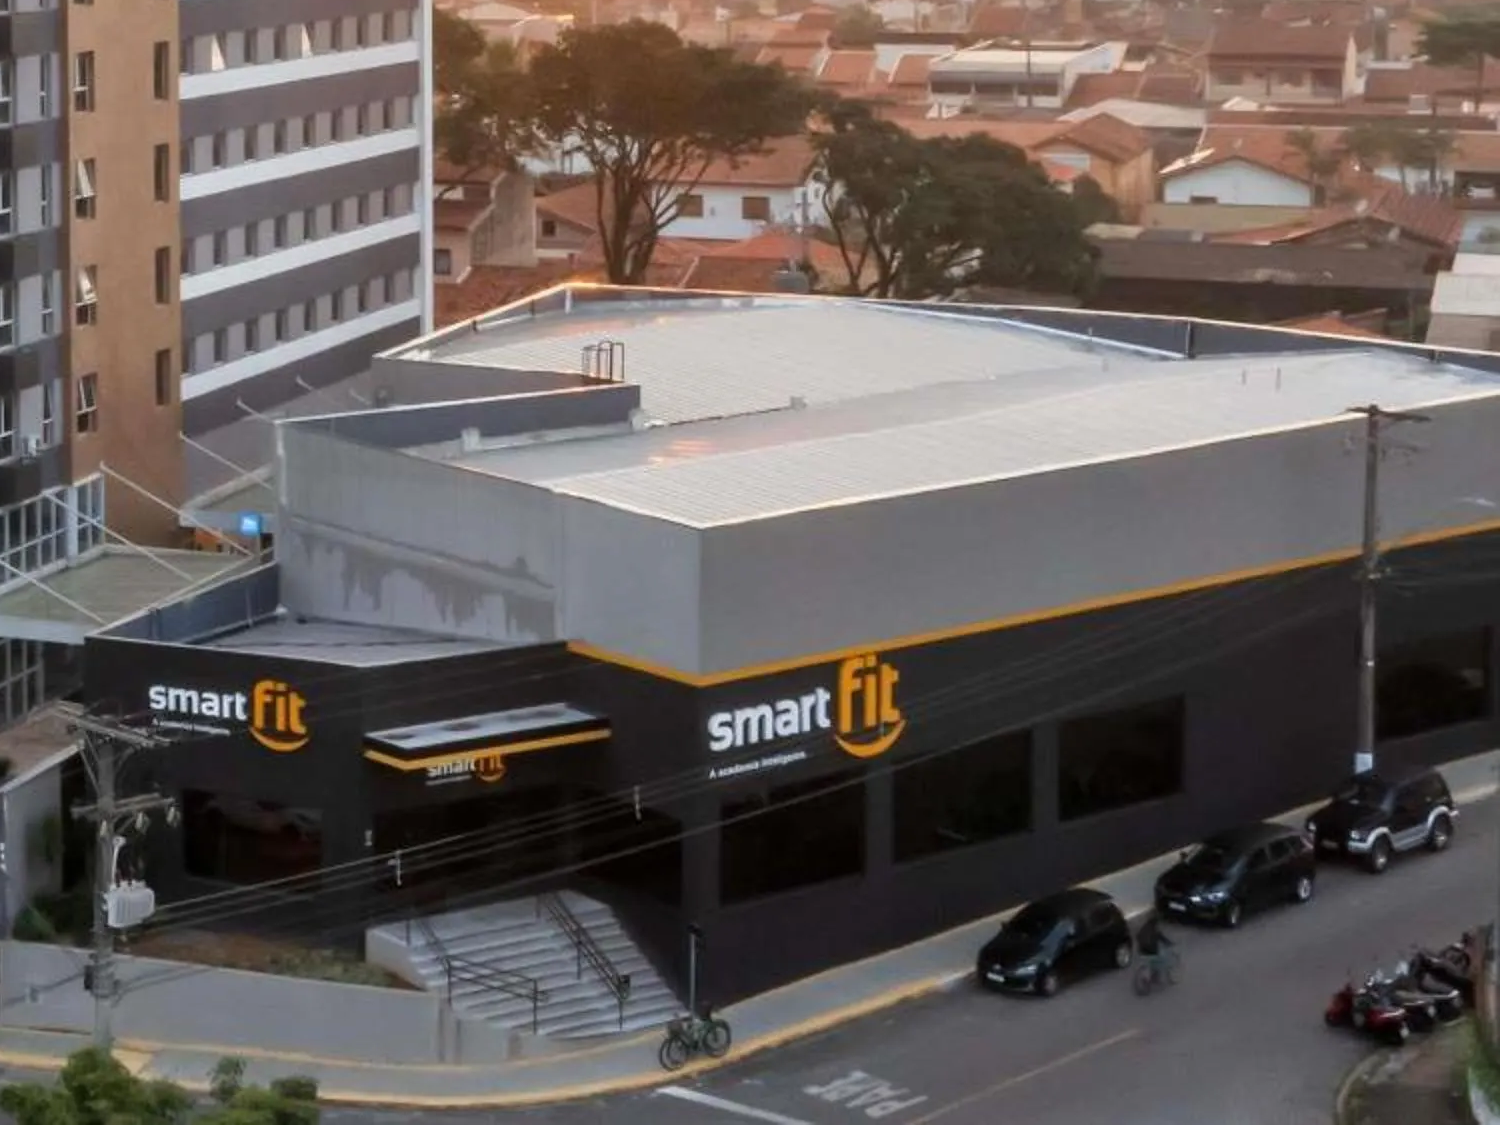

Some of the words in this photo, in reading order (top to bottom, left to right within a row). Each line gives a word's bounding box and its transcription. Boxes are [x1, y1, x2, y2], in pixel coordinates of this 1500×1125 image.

[148, 684, 248, 721] smart
[253, 679, 307, 736] fit
[707, 685, 832, 753] smart
[839, 652, 901, 735] fit
